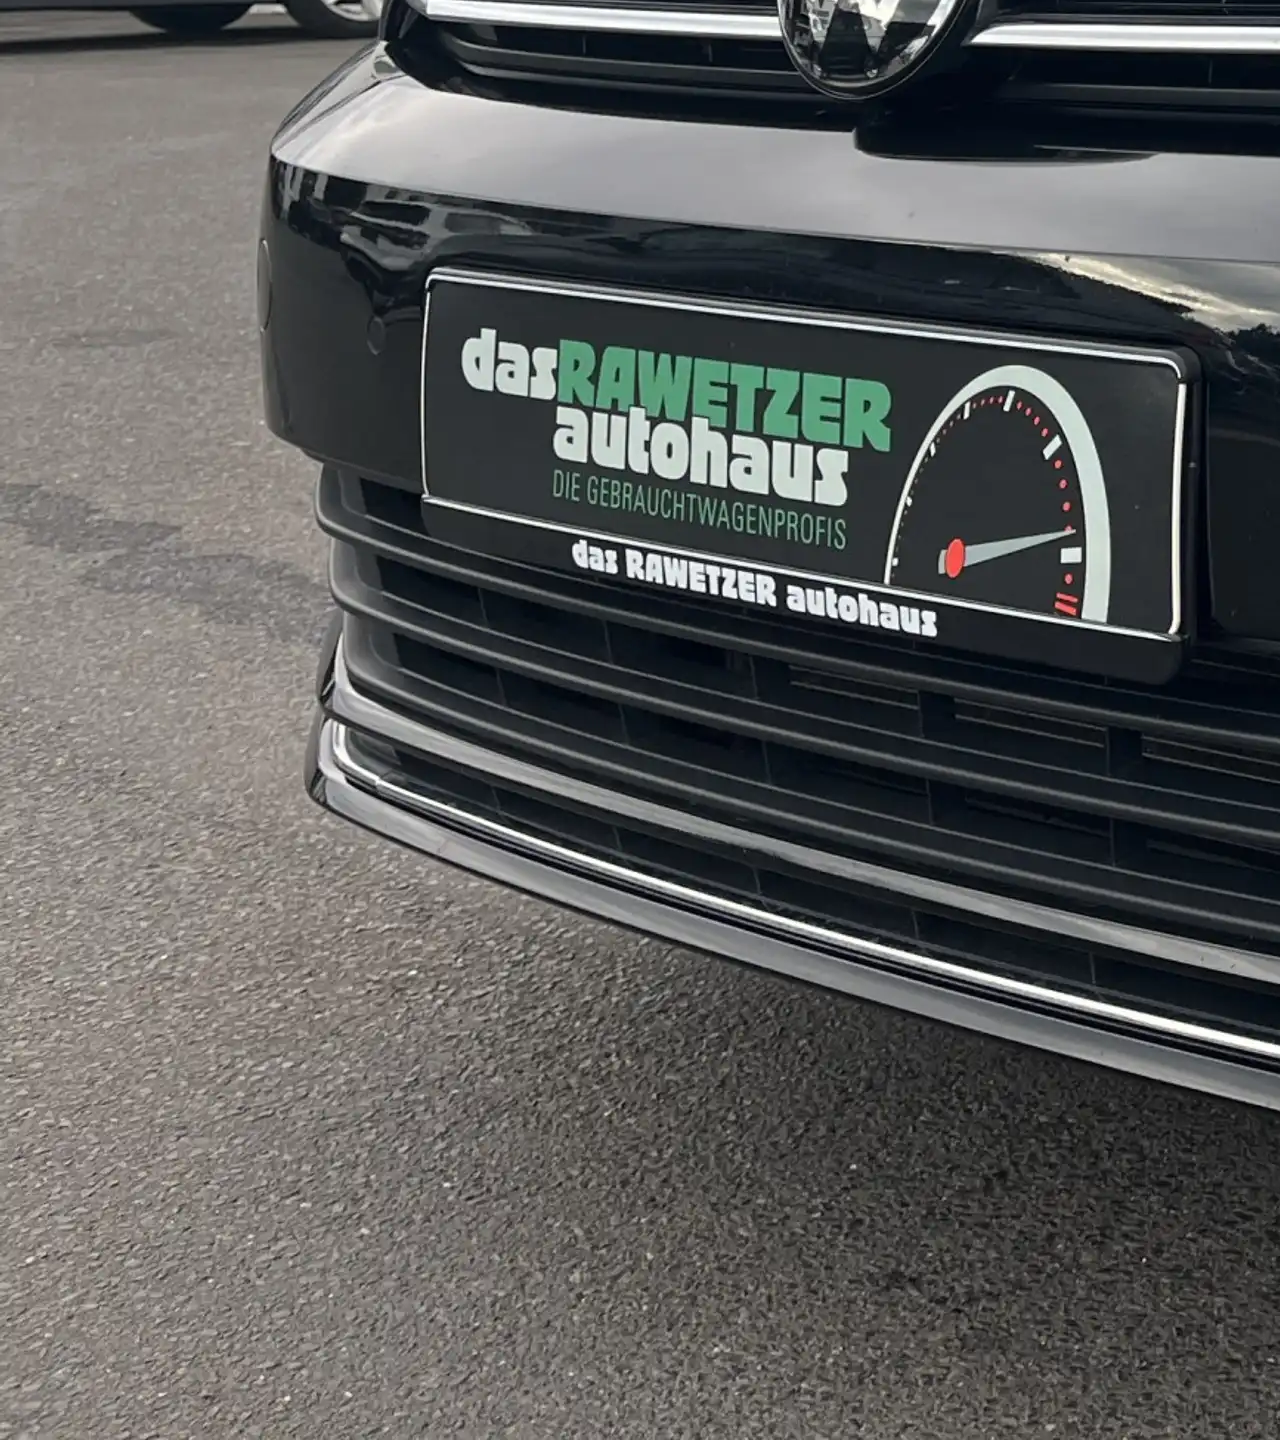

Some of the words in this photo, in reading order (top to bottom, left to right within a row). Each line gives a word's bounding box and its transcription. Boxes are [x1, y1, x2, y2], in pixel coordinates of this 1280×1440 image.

[553, 406, 849, 506] autohaus
[553, 469, 580, 502] DIE
[587, 475, 847, 550] GEBRAUCHTWAGENPROFIS
[571, 539, 618, 574] das
[625, 548, 777, 607] RAWETZER
[786, 584, 938, 638] autohaus
